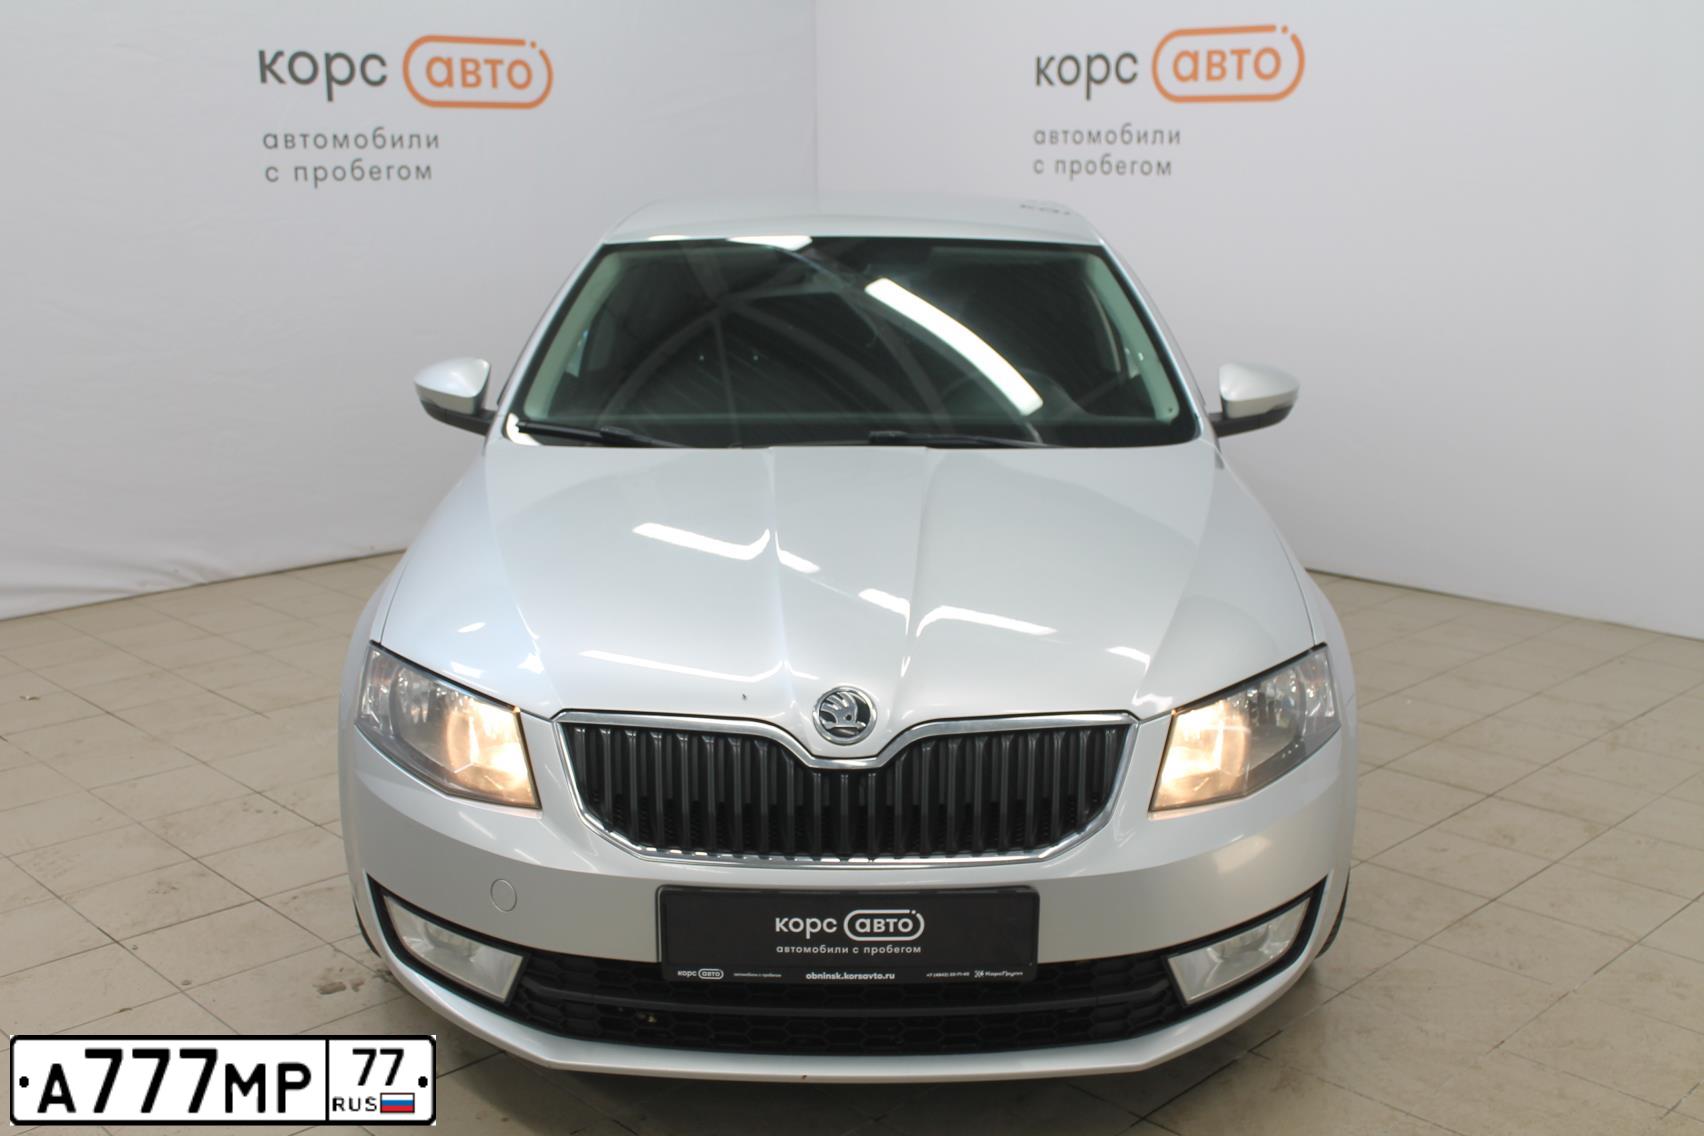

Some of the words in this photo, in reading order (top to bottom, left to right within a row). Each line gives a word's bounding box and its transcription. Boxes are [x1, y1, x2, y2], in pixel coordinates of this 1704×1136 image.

[258, 49, 388, 102] корс
[425, 55, 533, 90] авто
[1035, 52, 1138, 101] корс
[1172, 47, 1282, 82] авто
[263, 126, 440, 150] автомобили
[1034, 123, 1181, 145] автомобили
[265, 164, 279, 183] с
[294, 158, 432, 189] пробегом
[1033, 159, 1044, 174] с
[1054, 154, 1172, 180] пробегом
[775, 917, 838, 940] корс
[855, 917, 914, 933] авто
[776, 944, 849, 954] автомобили
[863, 944, 922, 956] пробегом
[805, 972, 896, 980] obninsk.korsavto.ru
